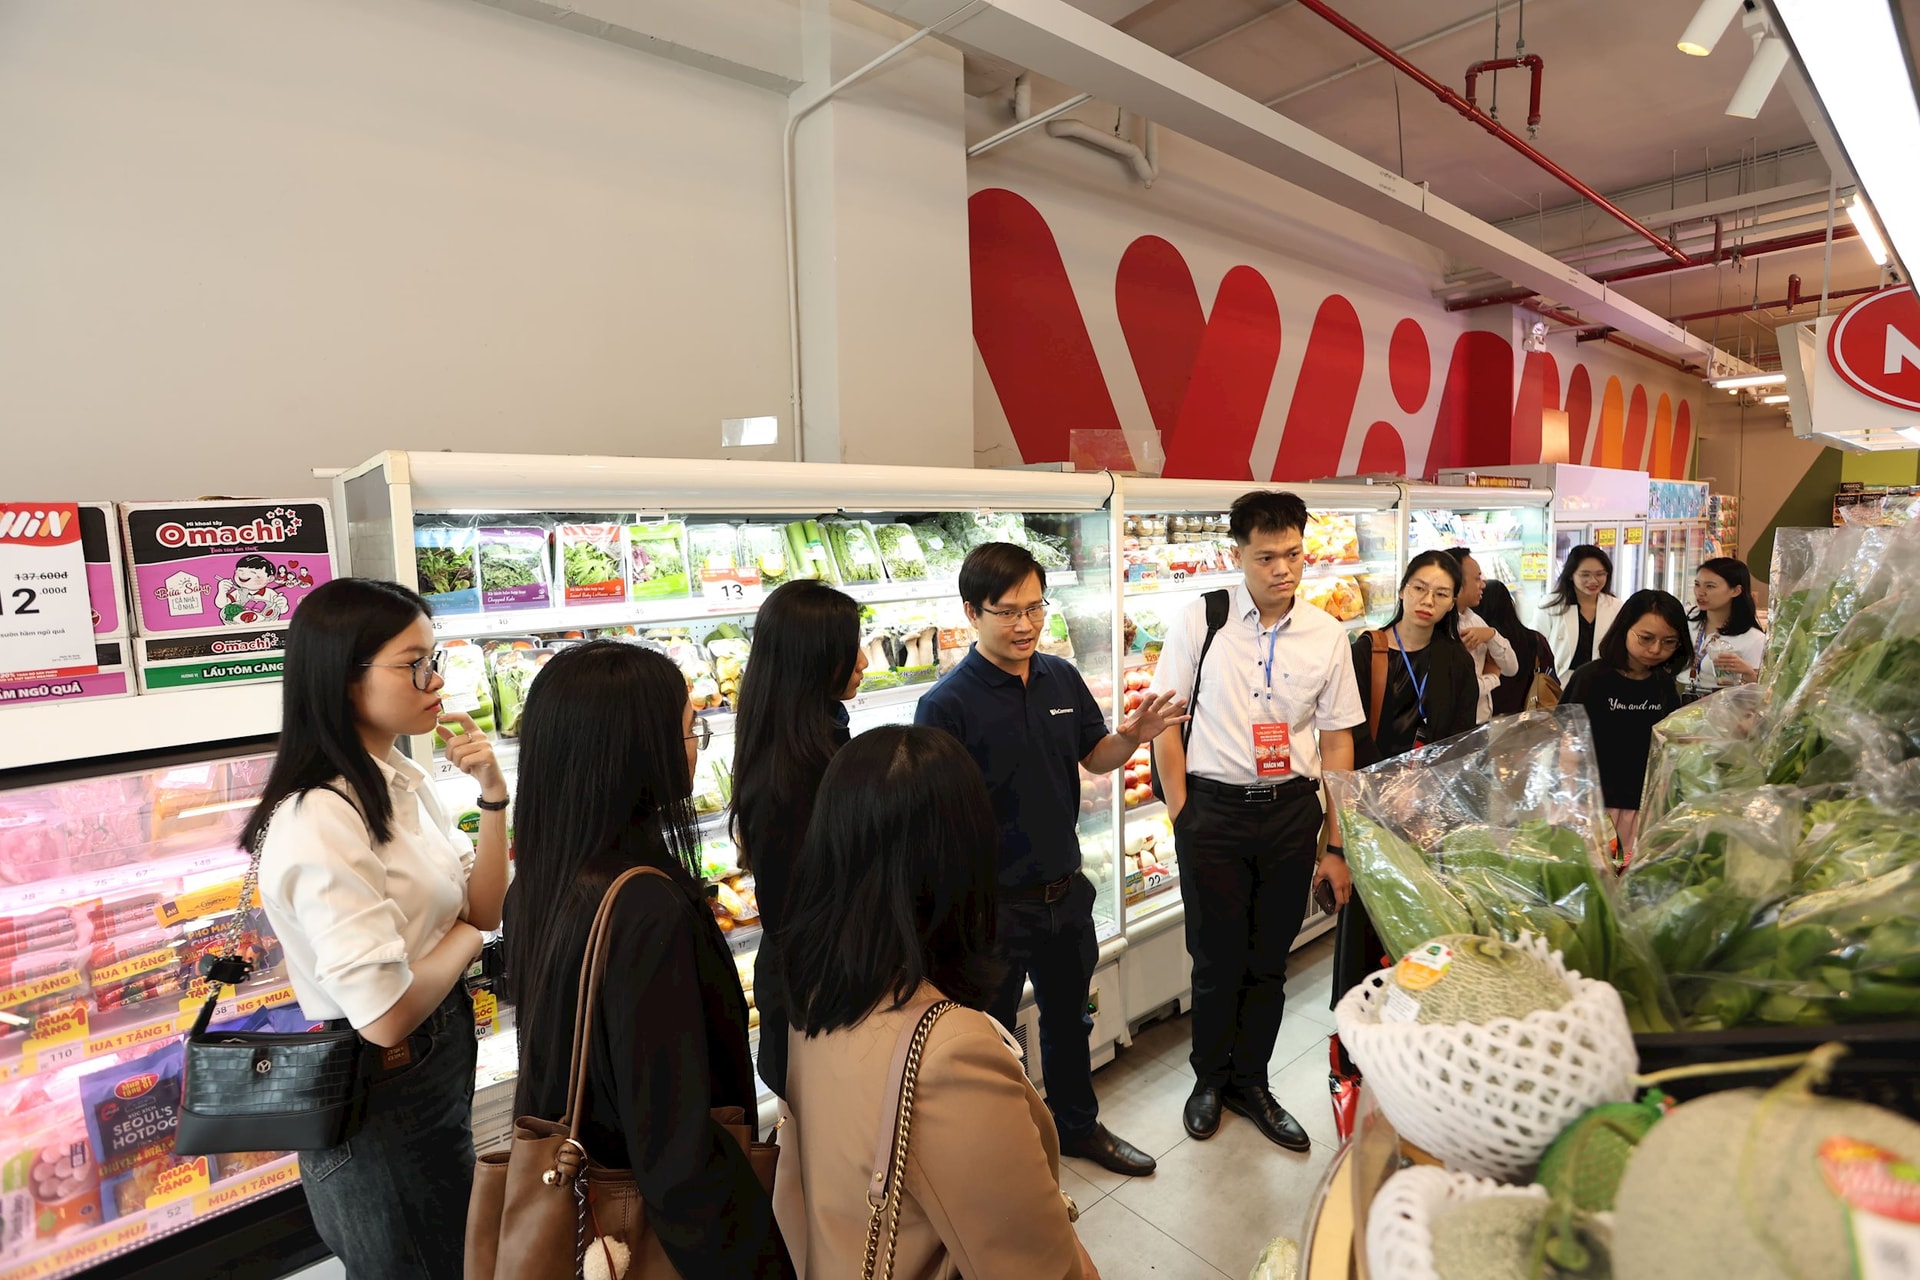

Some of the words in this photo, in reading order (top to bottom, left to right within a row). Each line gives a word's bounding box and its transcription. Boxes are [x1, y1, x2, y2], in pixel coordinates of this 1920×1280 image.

[156, 518, 286, 548] Omachi
[211, 637, 271, 653] Omachi
[227, 665, 253, 675] TÔM
[254, 661, 284, 673] CÀNG
[18, 685, 49, 698] NGŨ
[50, 682, 81, 697] QUẢ
[1608, 697, 1626, 711] You
[1628, 700, 1647, 710] and
[132, 954, 167, 971] TẶNG
[31, 976, 70, 993] TẶNG
[264, 990, 291, 1005] MUA
[36, 1012, 71, 1030] MUA
[70, 1007, 87, 1027] 1
[126, 1026, 163, 1043] TẶNG
[165, 1023, 172, 1033] 1
[50, 1048, 73, 1062] 110
[113, 1105, 173, 1137] SEOUL'S
[112, 1116, 179, 1150] HOTDOG
[158, 1163, 192, 1183] MUA
[191, 1157, 207, 1177] 1
[153, 1174, 193, 1196] TẶNG
[207, 1189, 239, 1207] MUA
[240, 1185, 248, 1194] 1
[251, 1171, 286, 1190] TẶNG
[287, 1167, 294, 1177] 1
